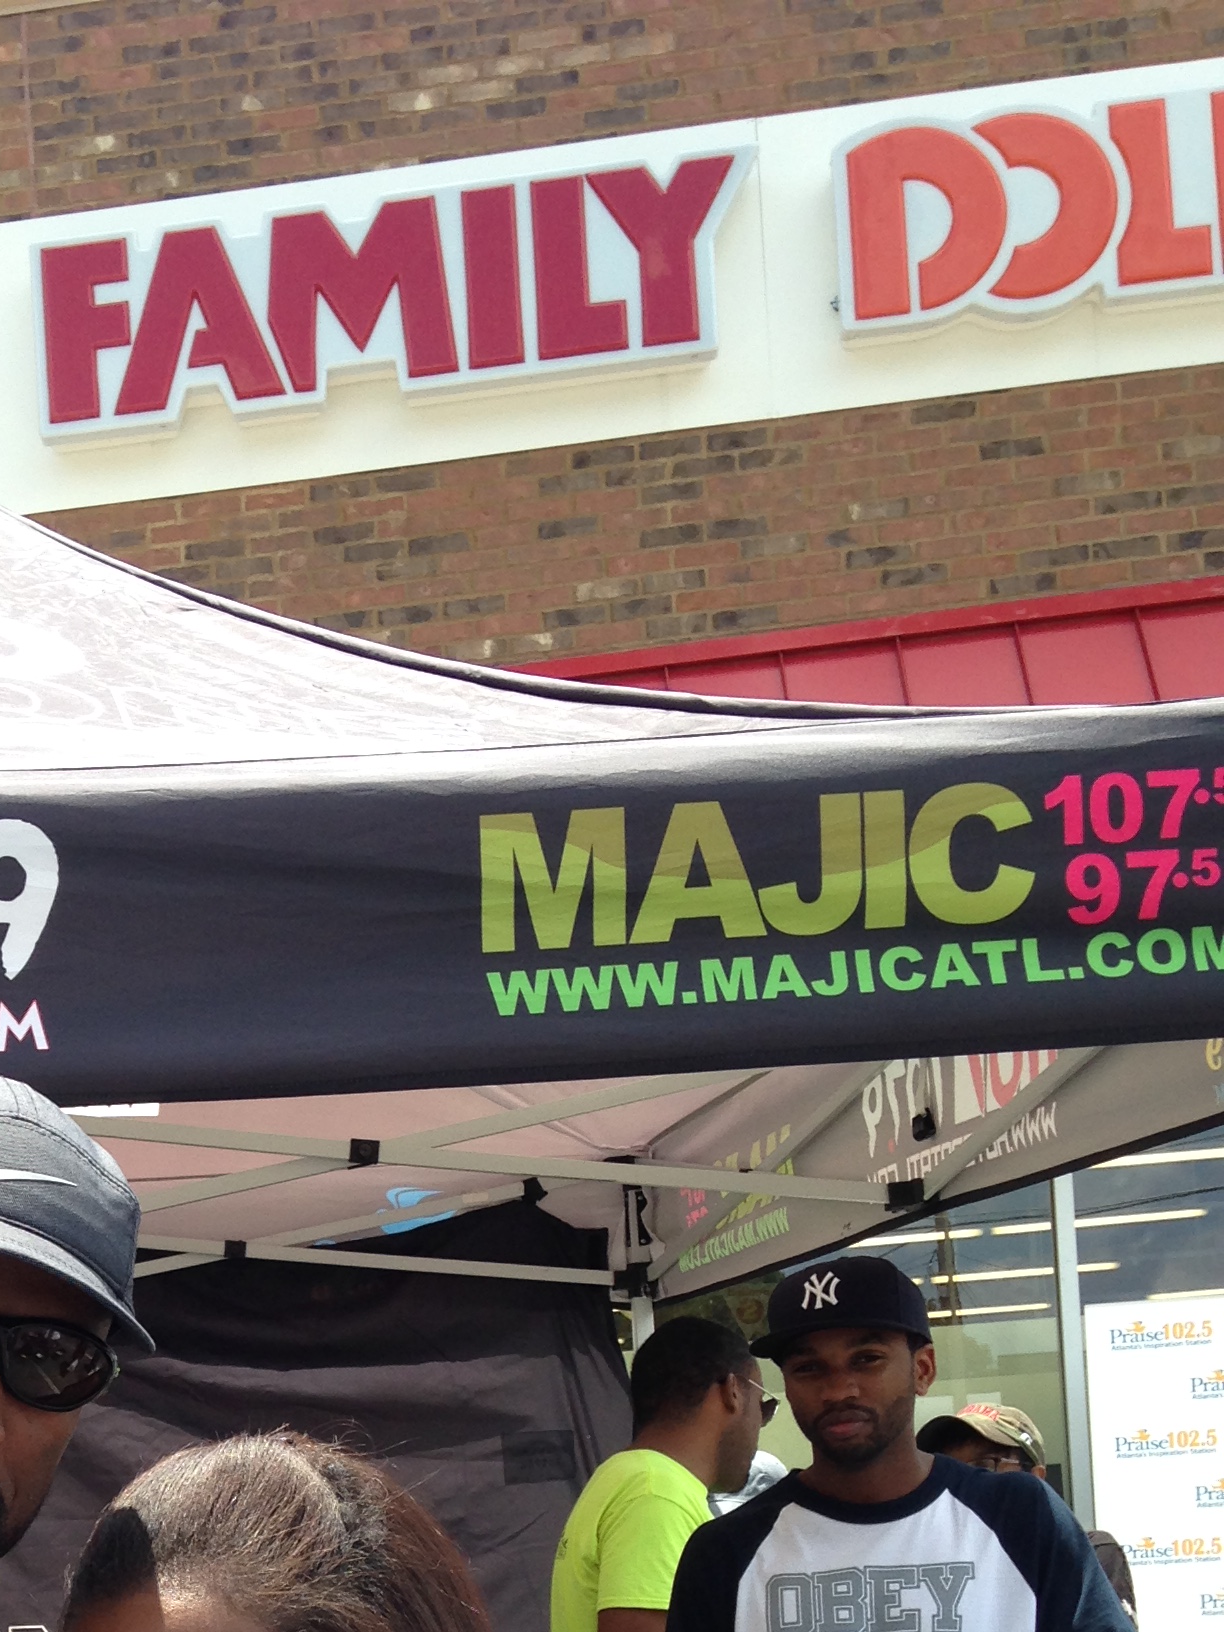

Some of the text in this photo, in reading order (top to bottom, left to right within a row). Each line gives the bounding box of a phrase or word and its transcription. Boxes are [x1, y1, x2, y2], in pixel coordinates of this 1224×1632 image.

[40, 90, 1224, 425] FAMILY DOL
[478, 782, 1036, 954] MAJIC
[1065, 847, 1222, 926] 97.5
